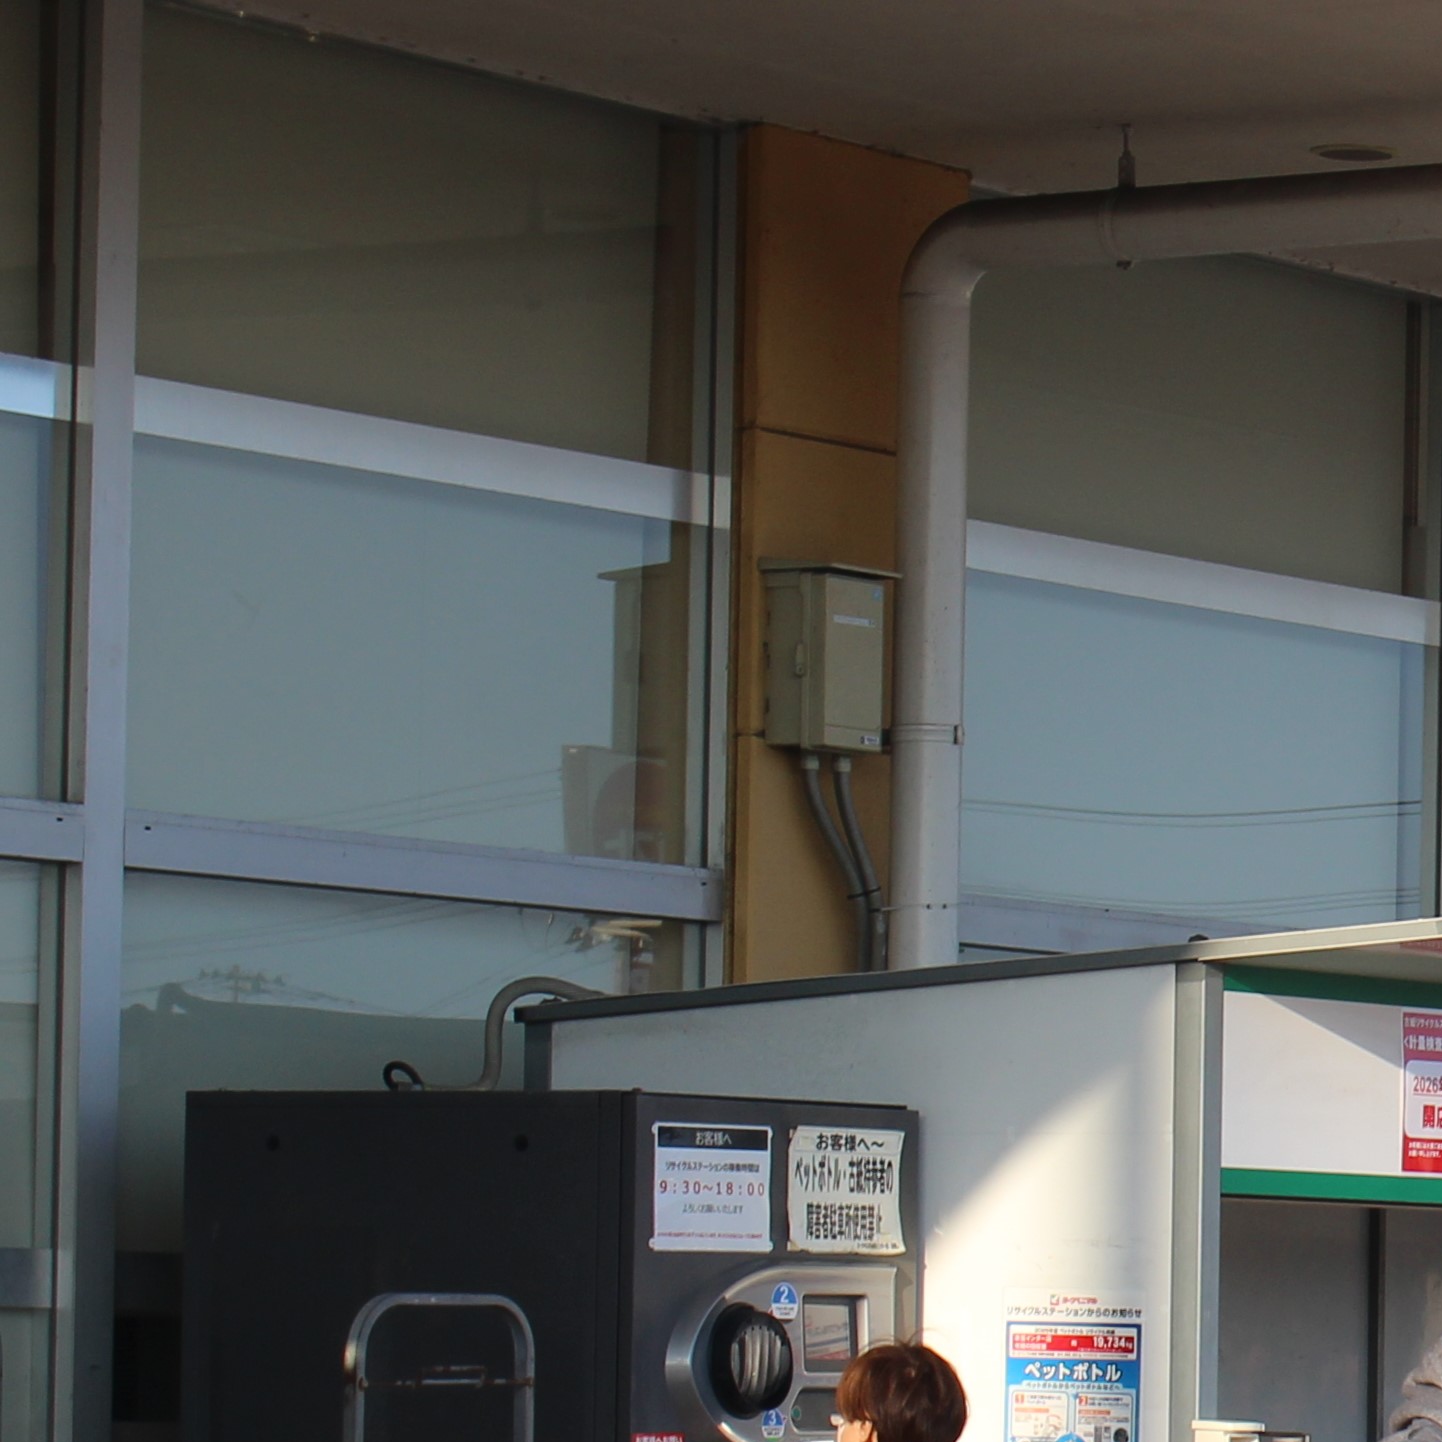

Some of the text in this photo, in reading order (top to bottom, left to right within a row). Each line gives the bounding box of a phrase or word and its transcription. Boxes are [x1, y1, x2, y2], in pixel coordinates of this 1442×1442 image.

[695, 1132, 732, 1146] お客様へ
[795, 1155, 893, 1194] ペットボトル・古紙持参者の
[780, 1286, 789, 1303] 2
[1025, 1361, 1121, 1382] ペットボトル
[769, 1410, 776, 1426] 3
